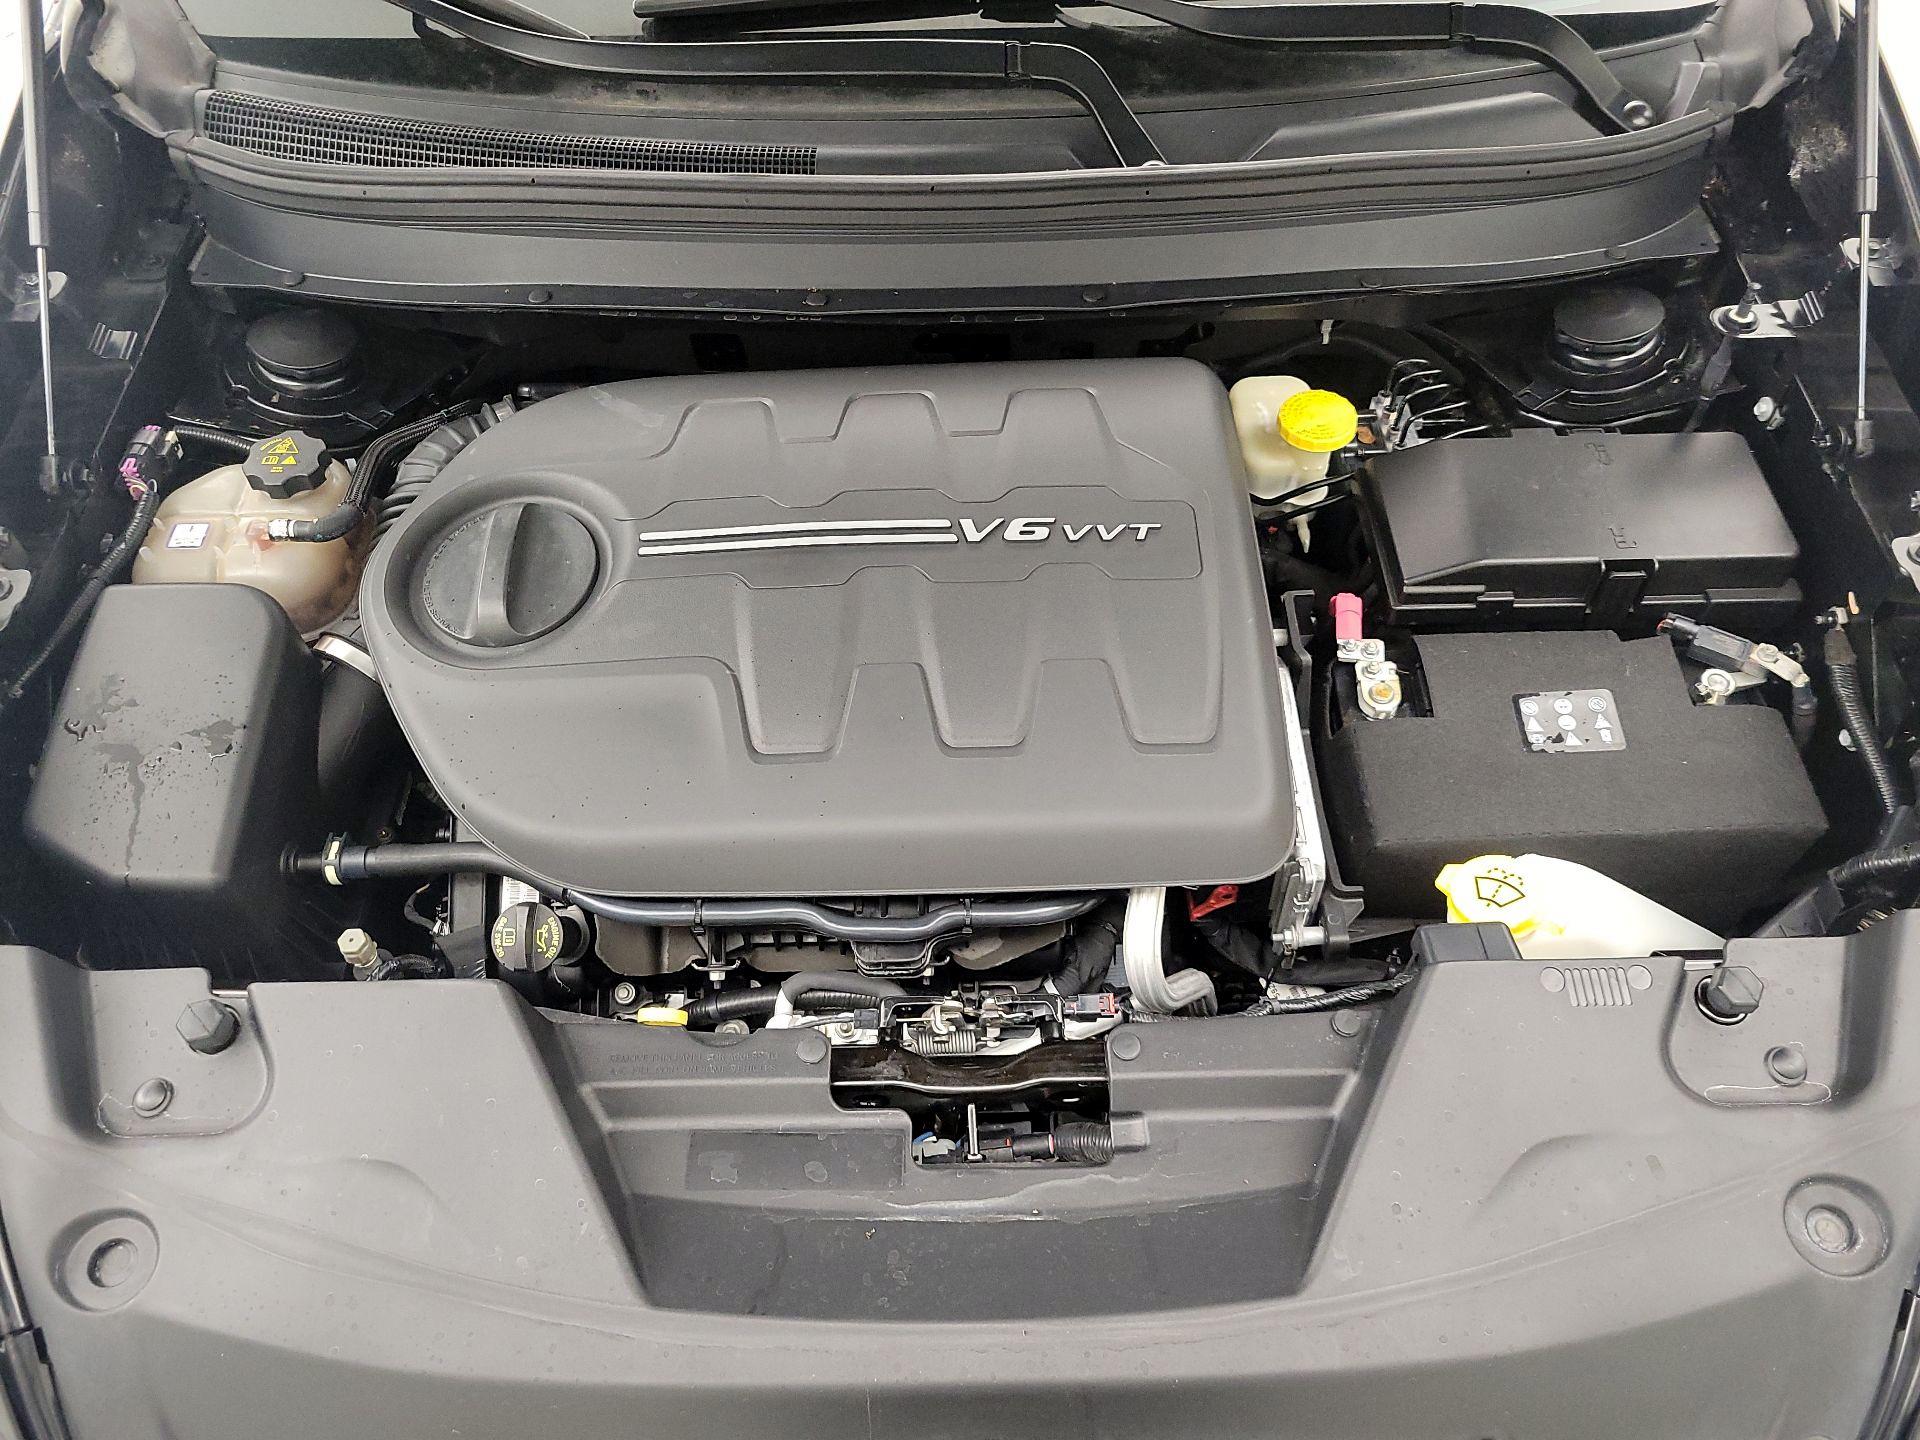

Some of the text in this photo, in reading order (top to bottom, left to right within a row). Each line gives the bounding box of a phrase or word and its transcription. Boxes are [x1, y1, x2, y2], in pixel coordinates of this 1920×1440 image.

[955, 516, 1163, 543] V6 VVT
[494, 916, 508, 958] SAE 5W-20
[544, 916, 560, 960] ENGINE OIL
